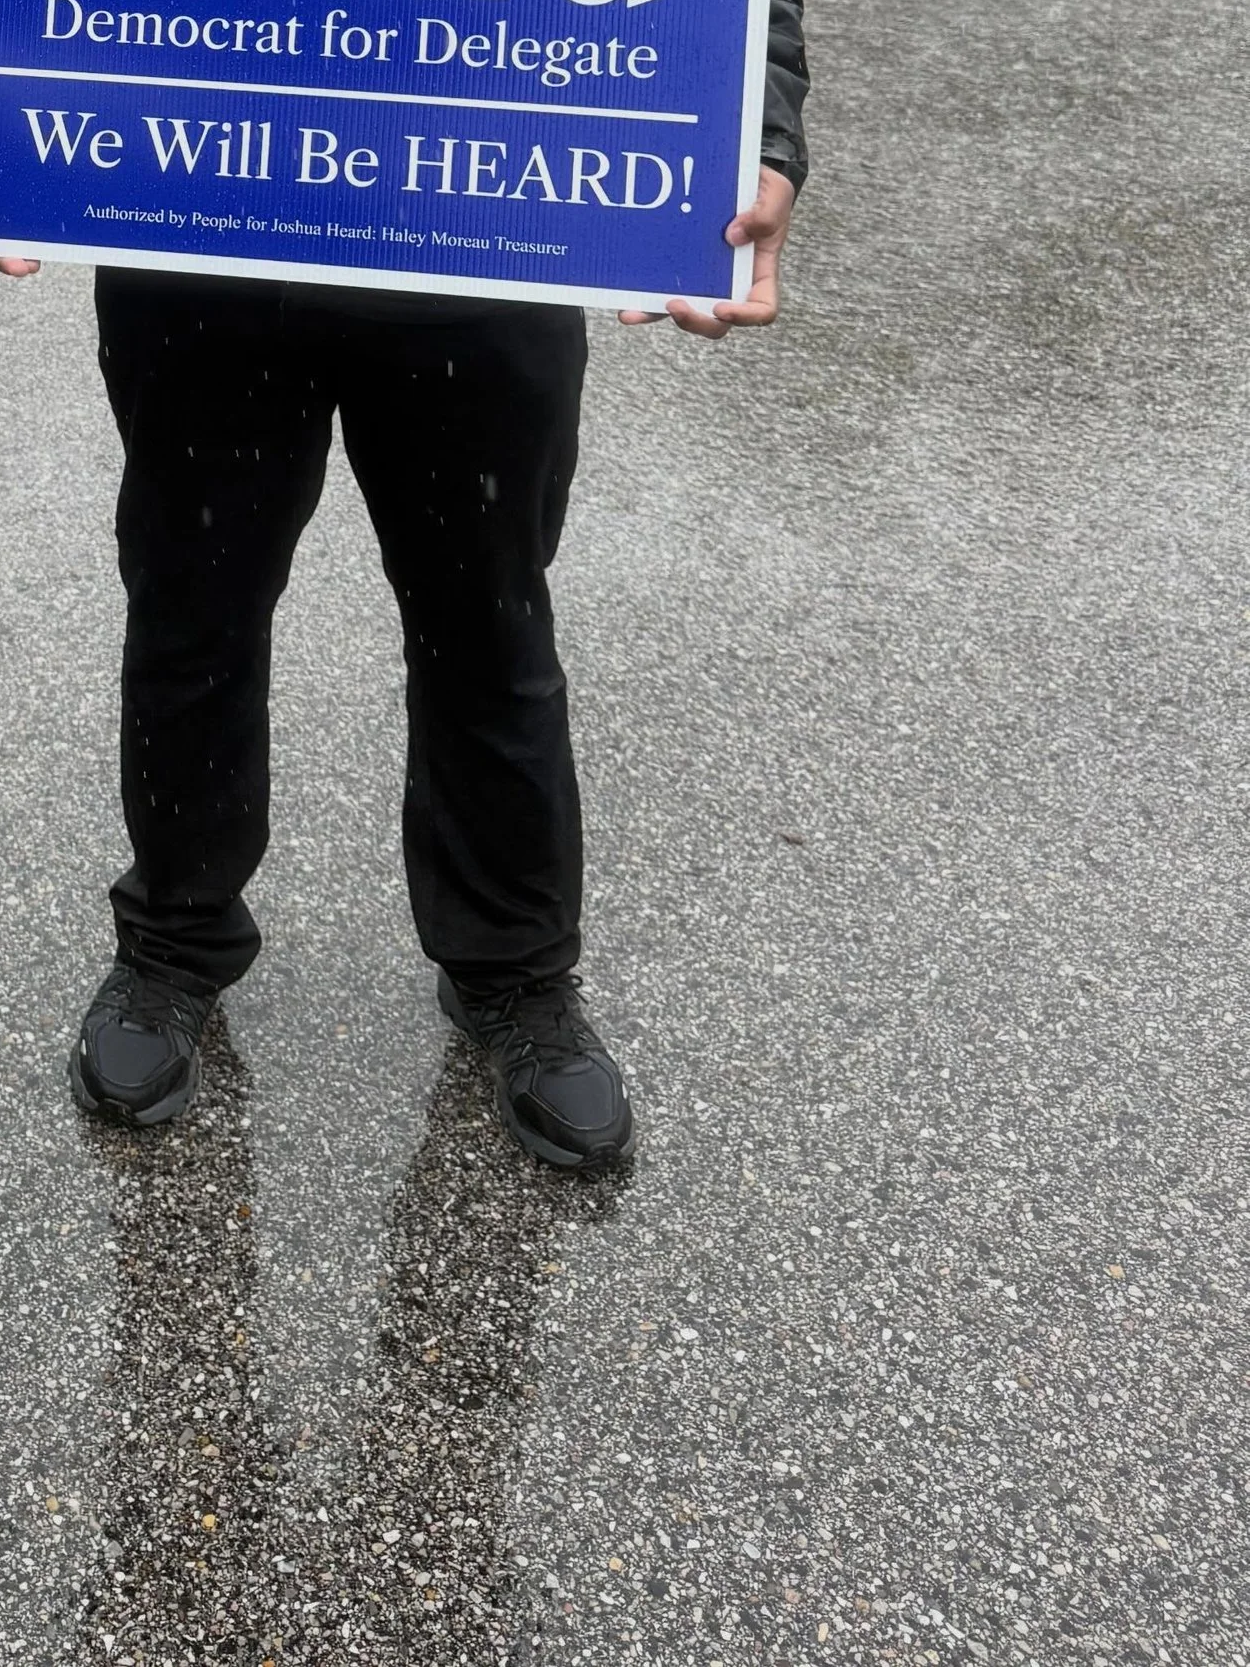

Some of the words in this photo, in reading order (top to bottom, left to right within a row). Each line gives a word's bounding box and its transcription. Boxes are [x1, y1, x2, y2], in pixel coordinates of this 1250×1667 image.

[320, 9, 399, 62] for
[413, 18, 659, 88] Delegate
[20, 108, 124, 169] We
[141, 116, 273, 180] Will
[295, 127, 380, 188] Be
[401, 135, 695, 214] HEARD!
[83, 204, 165, 223] Authorized
[168, 209, 187, 228] by
[191, 211, 241, 232] People
[246, 215, 268, 231] for
[270, 218, 322, 236] Joshua
[326, 222, 376, 240] Heard:
[381, 226, 427, 248] Haley
[431, 230, 490, 250] Moreau
[494, 235, 569, 256] Treasurer
